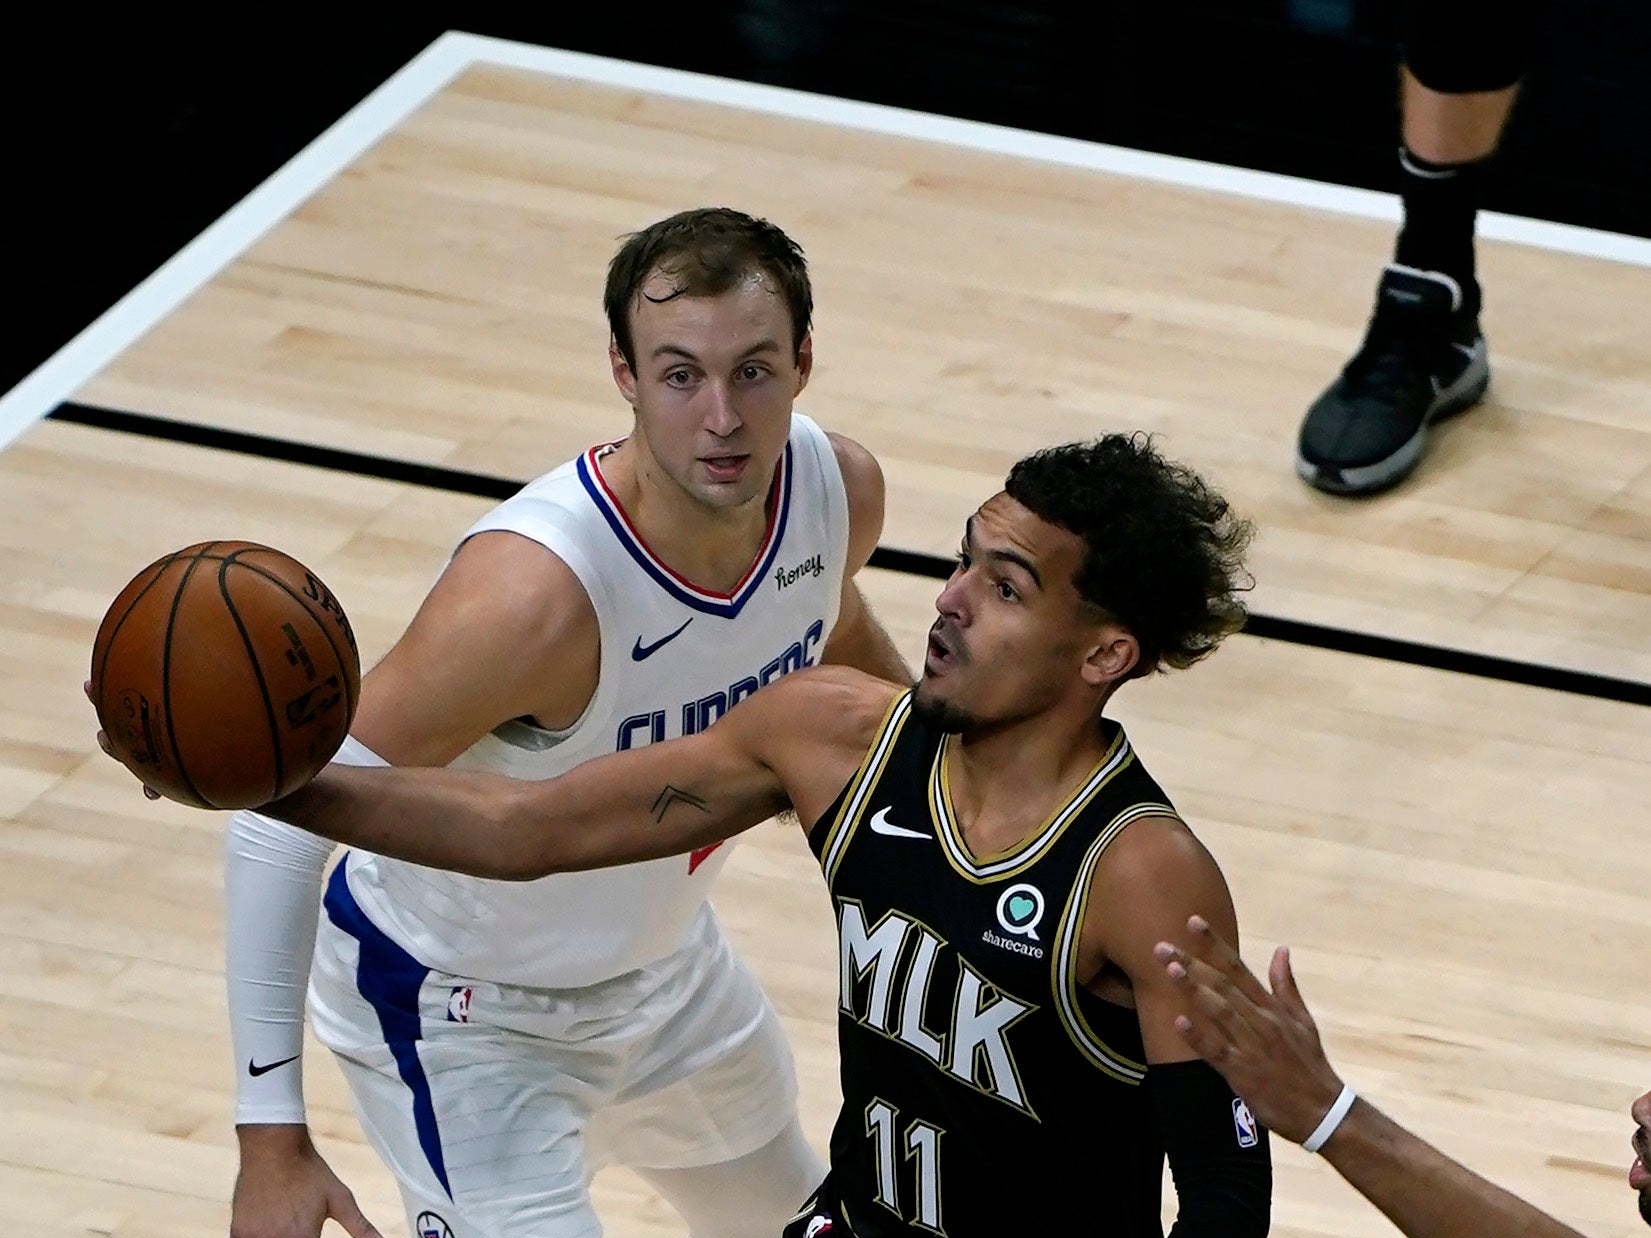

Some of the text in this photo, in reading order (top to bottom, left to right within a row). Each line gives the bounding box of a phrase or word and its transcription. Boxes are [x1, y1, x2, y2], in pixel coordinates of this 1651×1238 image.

[774, 554, 825, 591] honey
[982, 929, 1044, 959] sharecare
[837, 895, 1041, 1124] MLK
